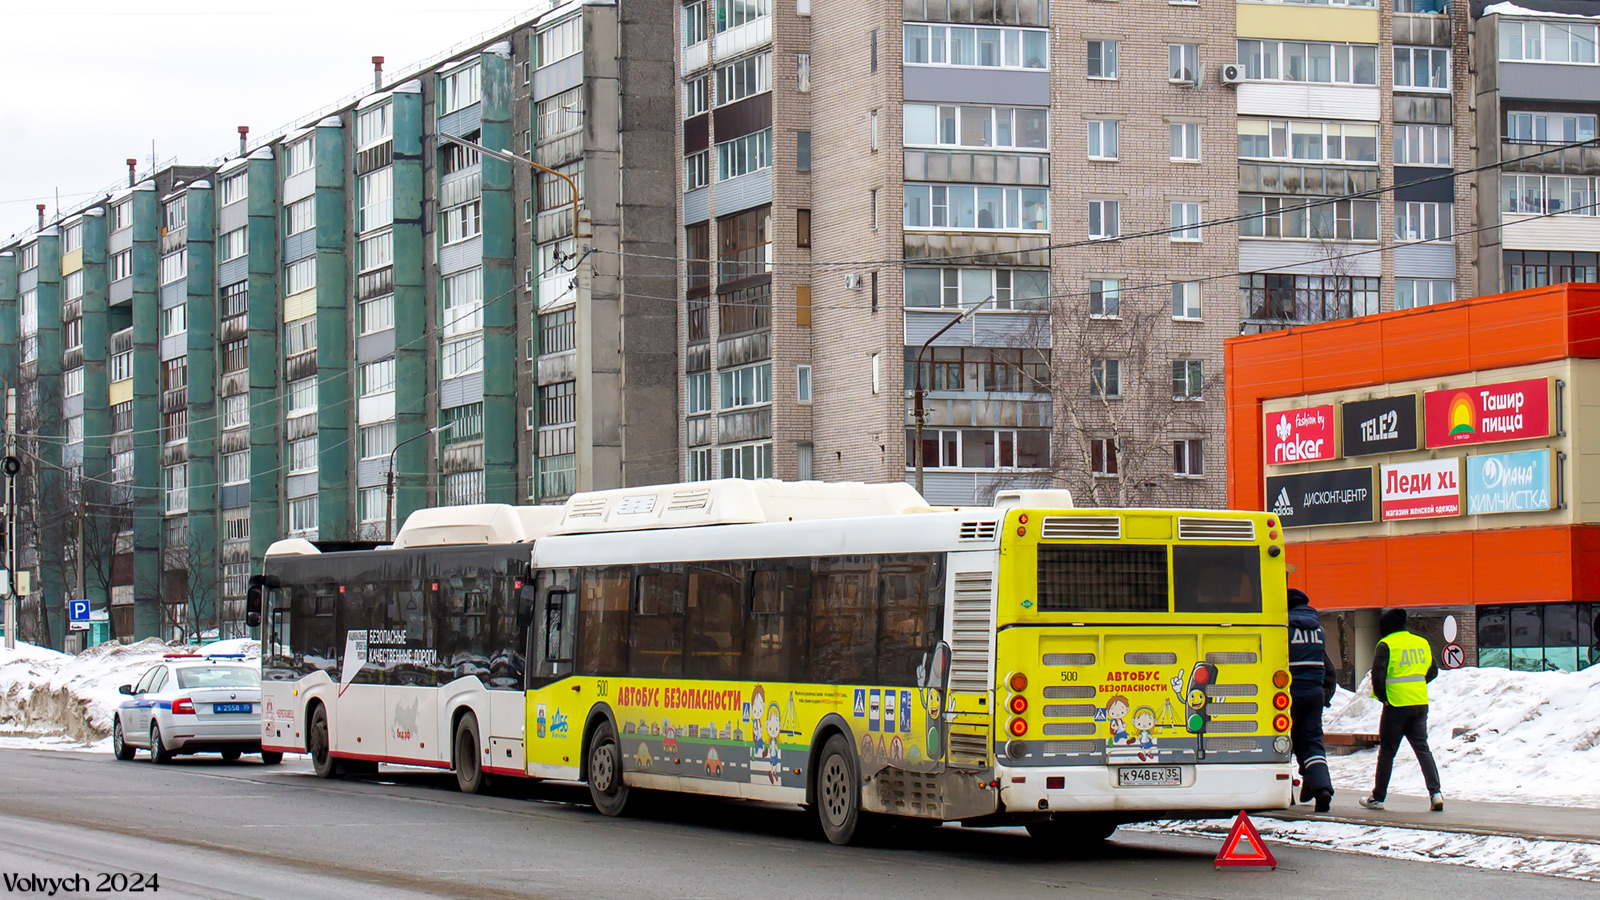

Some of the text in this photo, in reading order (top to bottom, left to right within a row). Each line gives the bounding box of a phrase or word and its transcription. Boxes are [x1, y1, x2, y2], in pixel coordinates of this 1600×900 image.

[1480, 391, 1524, 413] Ташир
[1295, 410, 1325, 430] fashion by
[1360, 410, 1398, 442] TELE2
[1482, 414, 1523, 433] пицца
[1274, 433, 1324, 462] rieker
[1386, 470, 1457, 494] Леди XL
[1303, 488, 1367, 507] ДИСКОНТ-ЦЕНТР
[1469, 489, 1548, 513] ХИМЧИСТКА
[1273, 504, 1294, 516] adidas
[1409, 505, 1434, 515] женской
[1435, 504, 1458, 514] одежды
[369, 630, 407, 644] БЕЗОПАСНЫЕ
[1291, 628, 1323, 644] ДПС
[368, 649, 412, 663] КАЧЕСТВЕННЫЕ
[413, 649, 437, 667] ДОРОГИ
[1400, 648, 1425, 667] ДПС
[1061, 671, 1078, 682] 500
[1106, 671, 1160, 681] АВТОБУС
[597, 680, 608, 697] 500
[1099, 684, 1168, 692] БЕЗОПАСНОСТИ
[618, 686, 741, 711] АВТОБУС БЕЗОПАСНОСТИ
